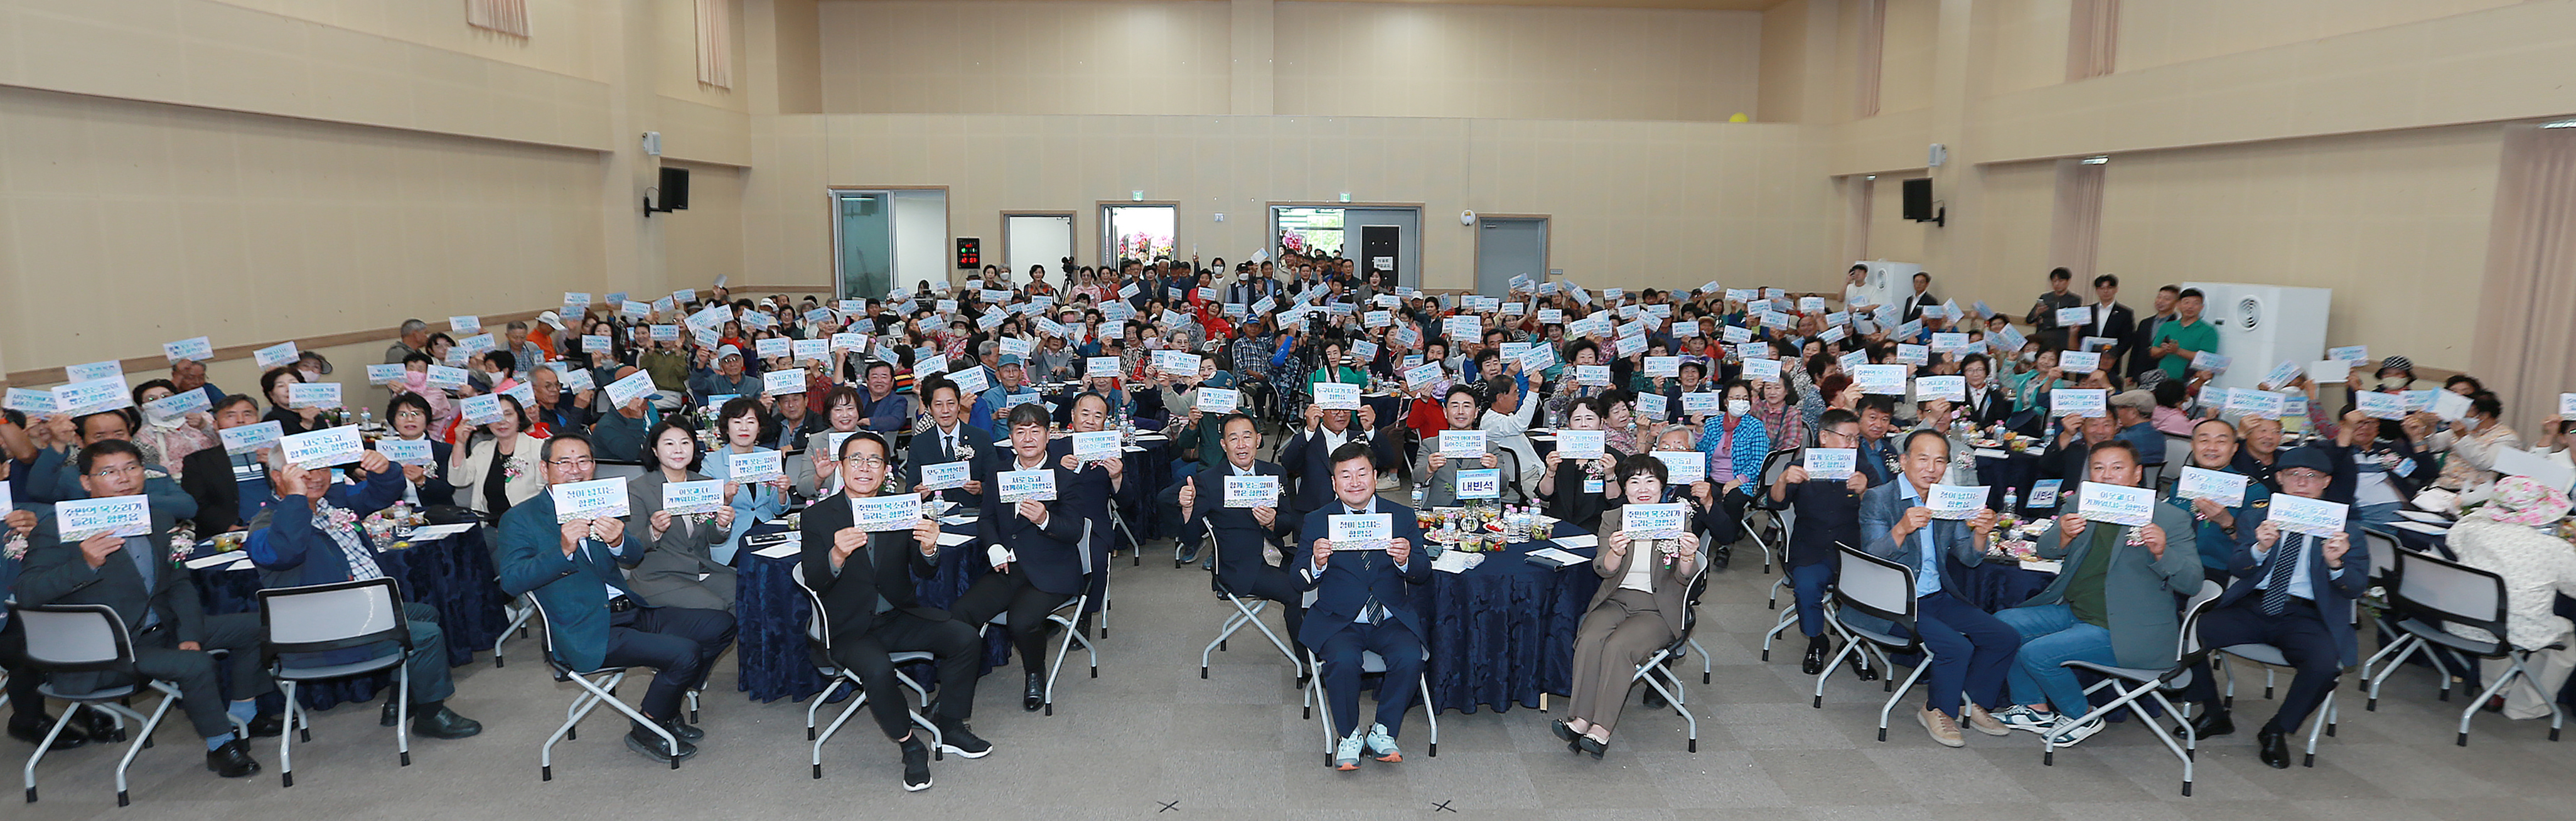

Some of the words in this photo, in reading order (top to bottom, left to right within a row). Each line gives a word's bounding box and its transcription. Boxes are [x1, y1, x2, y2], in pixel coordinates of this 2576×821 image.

[299, 438, 323, 448] 서로
[323, 434, 342, 444] 돕고
[289, 444, 329, 459] 함께하는
[330, 439, 357, 450] 함평읍
[1463, 481, 1493, 491] 내빈석
[567, 490, 585, 500] 정이
[587, 486, 614, 497] 넘치는
[2033, 490, 2055, 500] 내빈석
[578, 497, 605, 508] 함평읍
[668, 495, 698, 505] 가까워지는
[700, 494, 720, 502] 함평읍
[63, 506, 98, 517] 주민의
[100, 502, 142, 514] 목소리가
[857, 503, 882, 512] 주민의
[884, 500, 916, 510] 목소리가
[70, 516, 105, 527] 들리는
[106, 513, 139, 524] 함평읍
[862, 512, 887, 520] 들리는
[889, 510, 913, 518] 함평읍
[1340, 522, 1355, 530] 정이
[1357, 521, 1380, 529] 넘치는
